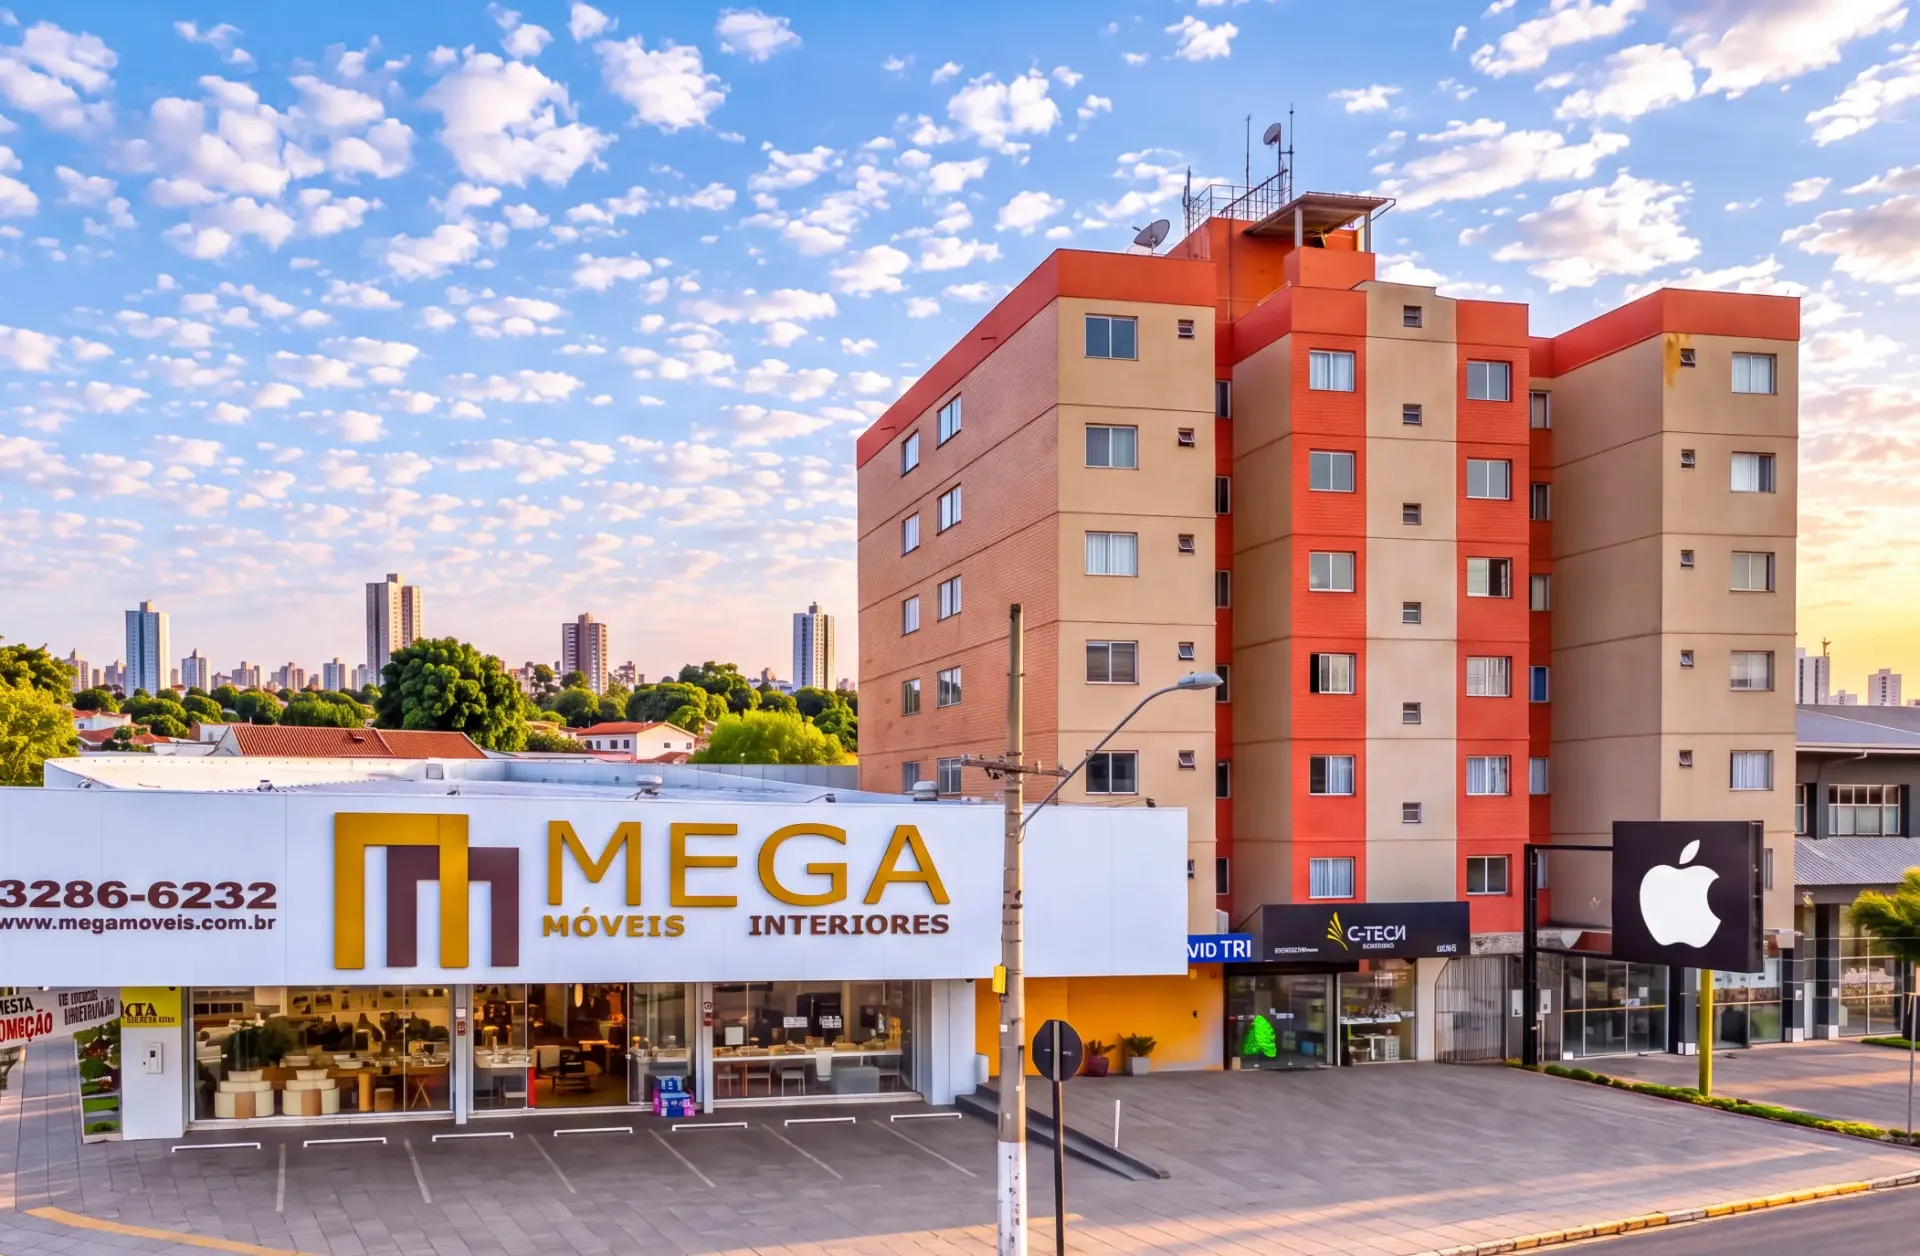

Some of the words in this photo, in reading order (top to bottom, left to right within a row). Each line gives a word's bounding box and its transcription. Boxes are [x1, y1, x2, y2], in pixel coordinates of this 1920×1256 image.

[547, 820, 951, 907] MEGA
[0, 880, 277, 909] 3286-6232
[0, 914, 276, 934] www.megamoveis.com.br
[542, 907, 685, 937] MÓVEIS
[748, 914, 950, 936] INTERIORES
[1220, 940, 1252, 958] TRI
